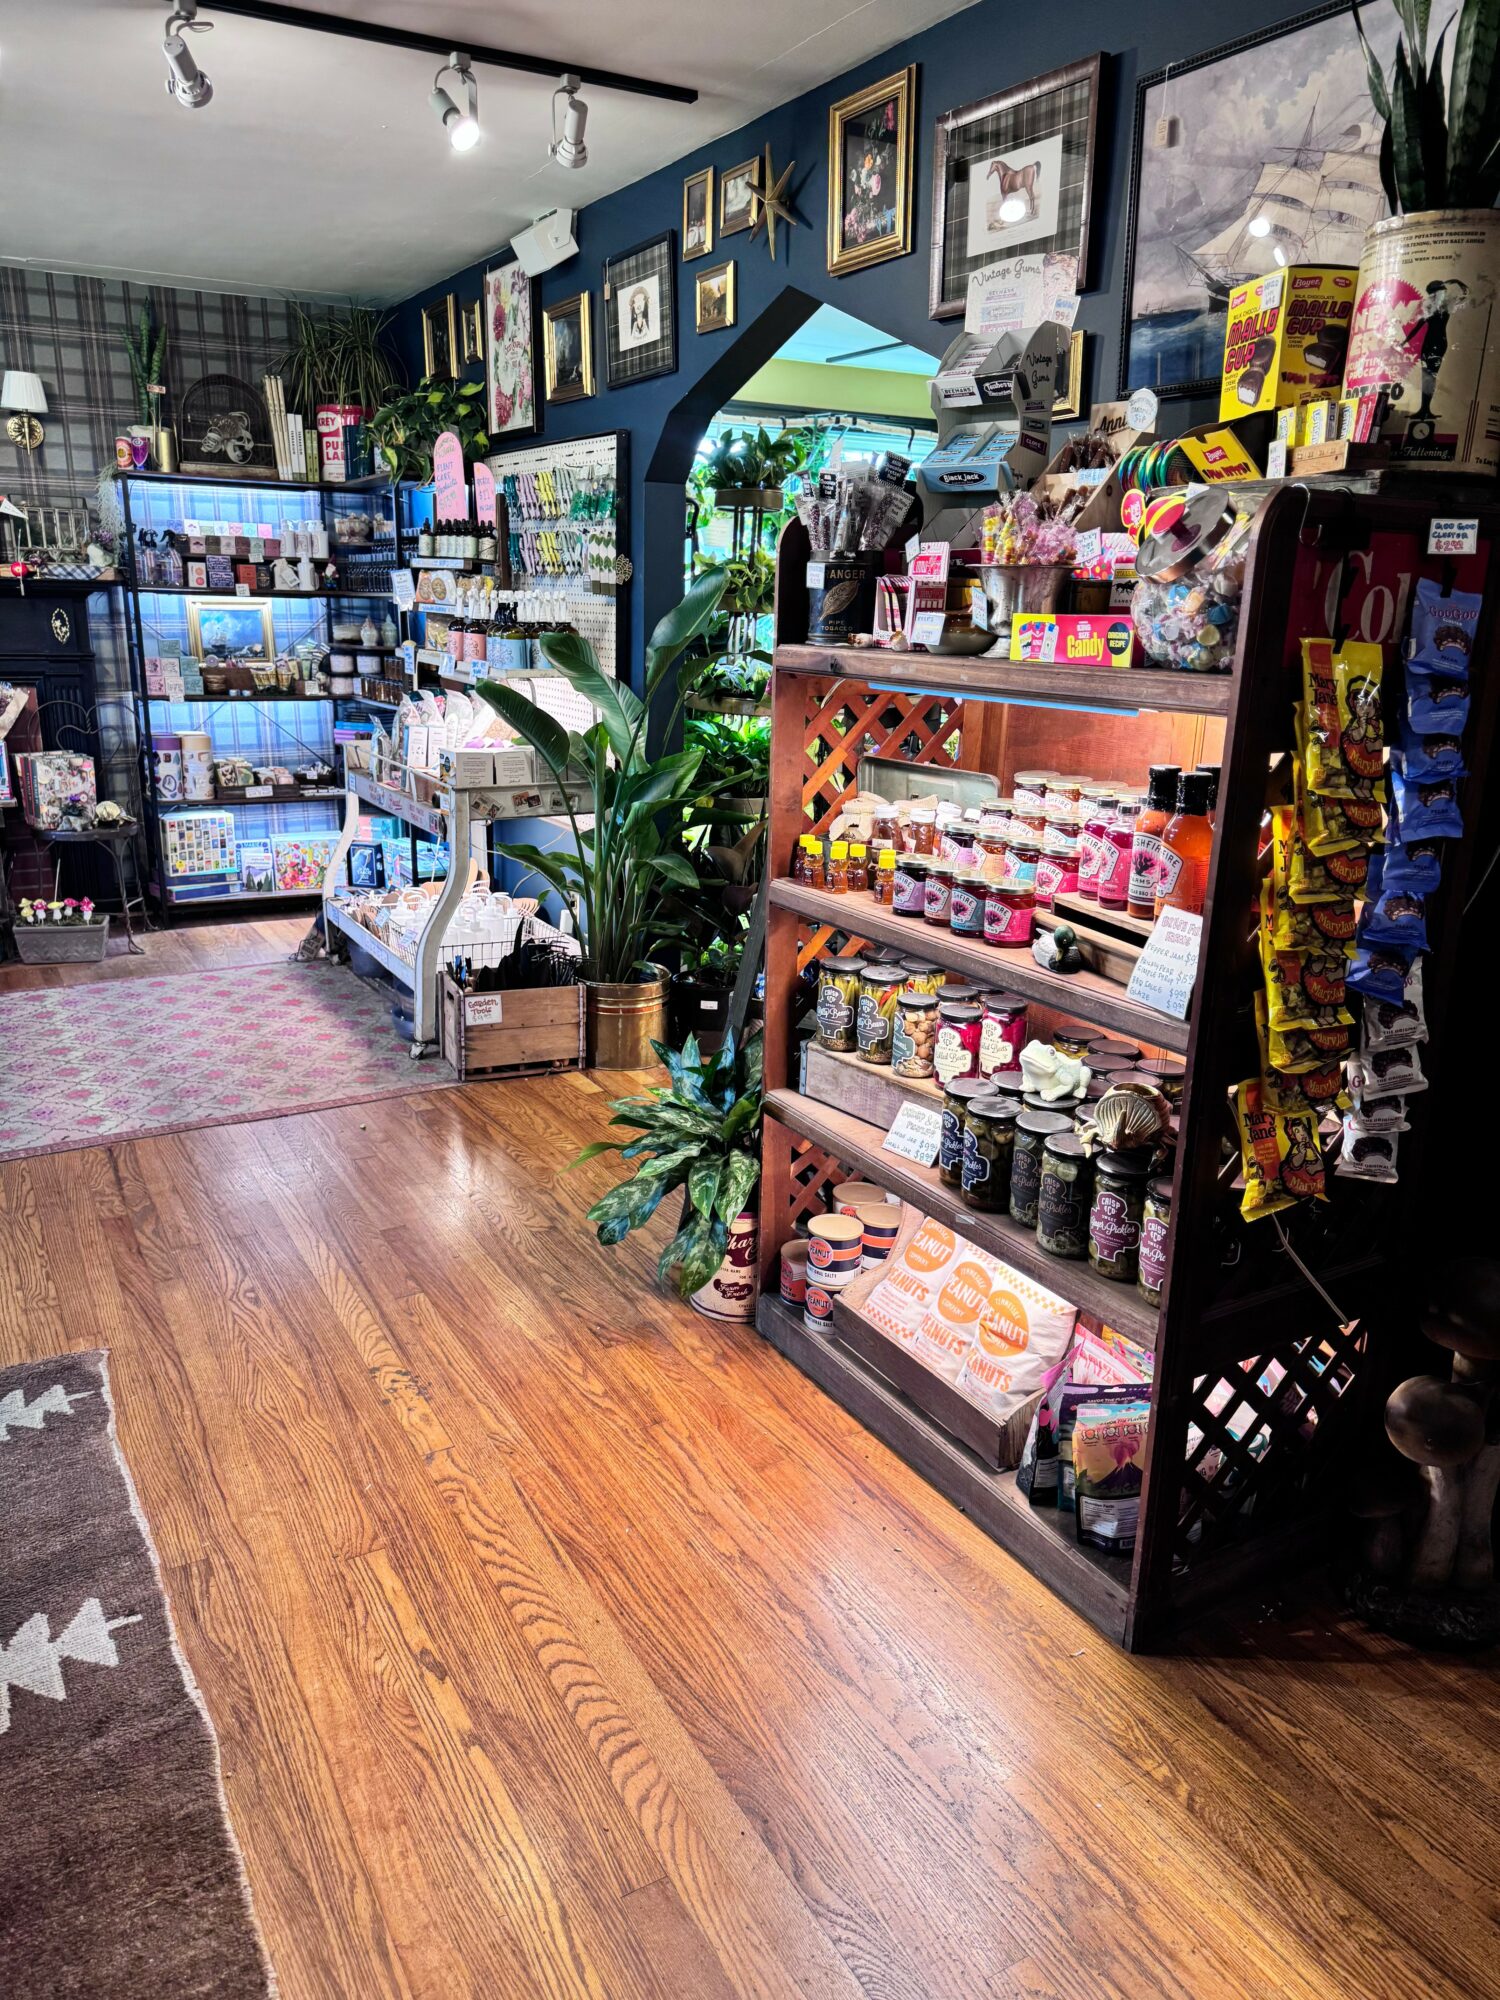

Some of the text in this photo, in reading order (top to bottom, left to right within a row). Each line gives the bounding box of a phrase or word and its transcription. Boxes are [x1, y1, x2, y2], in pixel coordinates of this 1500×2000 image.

[972, 258, 1042, 287] Vintage Gums
[1287, 299, 1354, 320] MALLO
[1227, 308, 1280, 349] MALLO
[1286, 317, 1326, 336] CUP
[1026, 352, 1054, 368] Vintage
[1225, 342, 1256, 375] CUP
[1031, 370, 1050, 390] Gums
[1094, 411, 1128, 433] Anni
[325, 441, 344, 451] PU
[326, 451, 344, 461] LA
[942, 471, 980, 483] Black Jack
[827, 569, 866, 579] ANGER
[1066, 631, 1105, 661] Candy
[1108, 640, 1126, 648] RECIPE
[1307, 672, 1340, 694] Mary
[1310, 688, 1339, 707] Jane
[1146, 942, 1198, 967] PEPPER JAM $9
[467, 998, 498, 1009] Garden
[471, 1006, 492, 1016] Tools
[1387, 1072, 1414, 1081] ORIGINAL
[1243, 1112, 1276, 1131] Mary
[1247, 1125, 1276, 1144] Jane
[1016, 1152, 1032, 1163] CRISP
[1044, 1177, 1061, 1189] CRISP
[1045, 1201, 1072, 1214] Pickles
[1101, 1197, 1121, 1210] CRISP
[1106, 1222, 1136, 1236] Pickles
[1147, 1222, 1167, 1236] CRISP
[810, 1245, 831, 1257] PEANUT
[887, 1266, 930, 1303] PEANUTS
[807, 1294, 829, 1309] PEANUT
[944, 1273, 986, 1318] PEANUT
[981, 1302, 1028, 1346] PEANUT
[921, 1314, 968, 1356] PEANUTS
[965, 1347, 1013, 1393] PEANUTS
